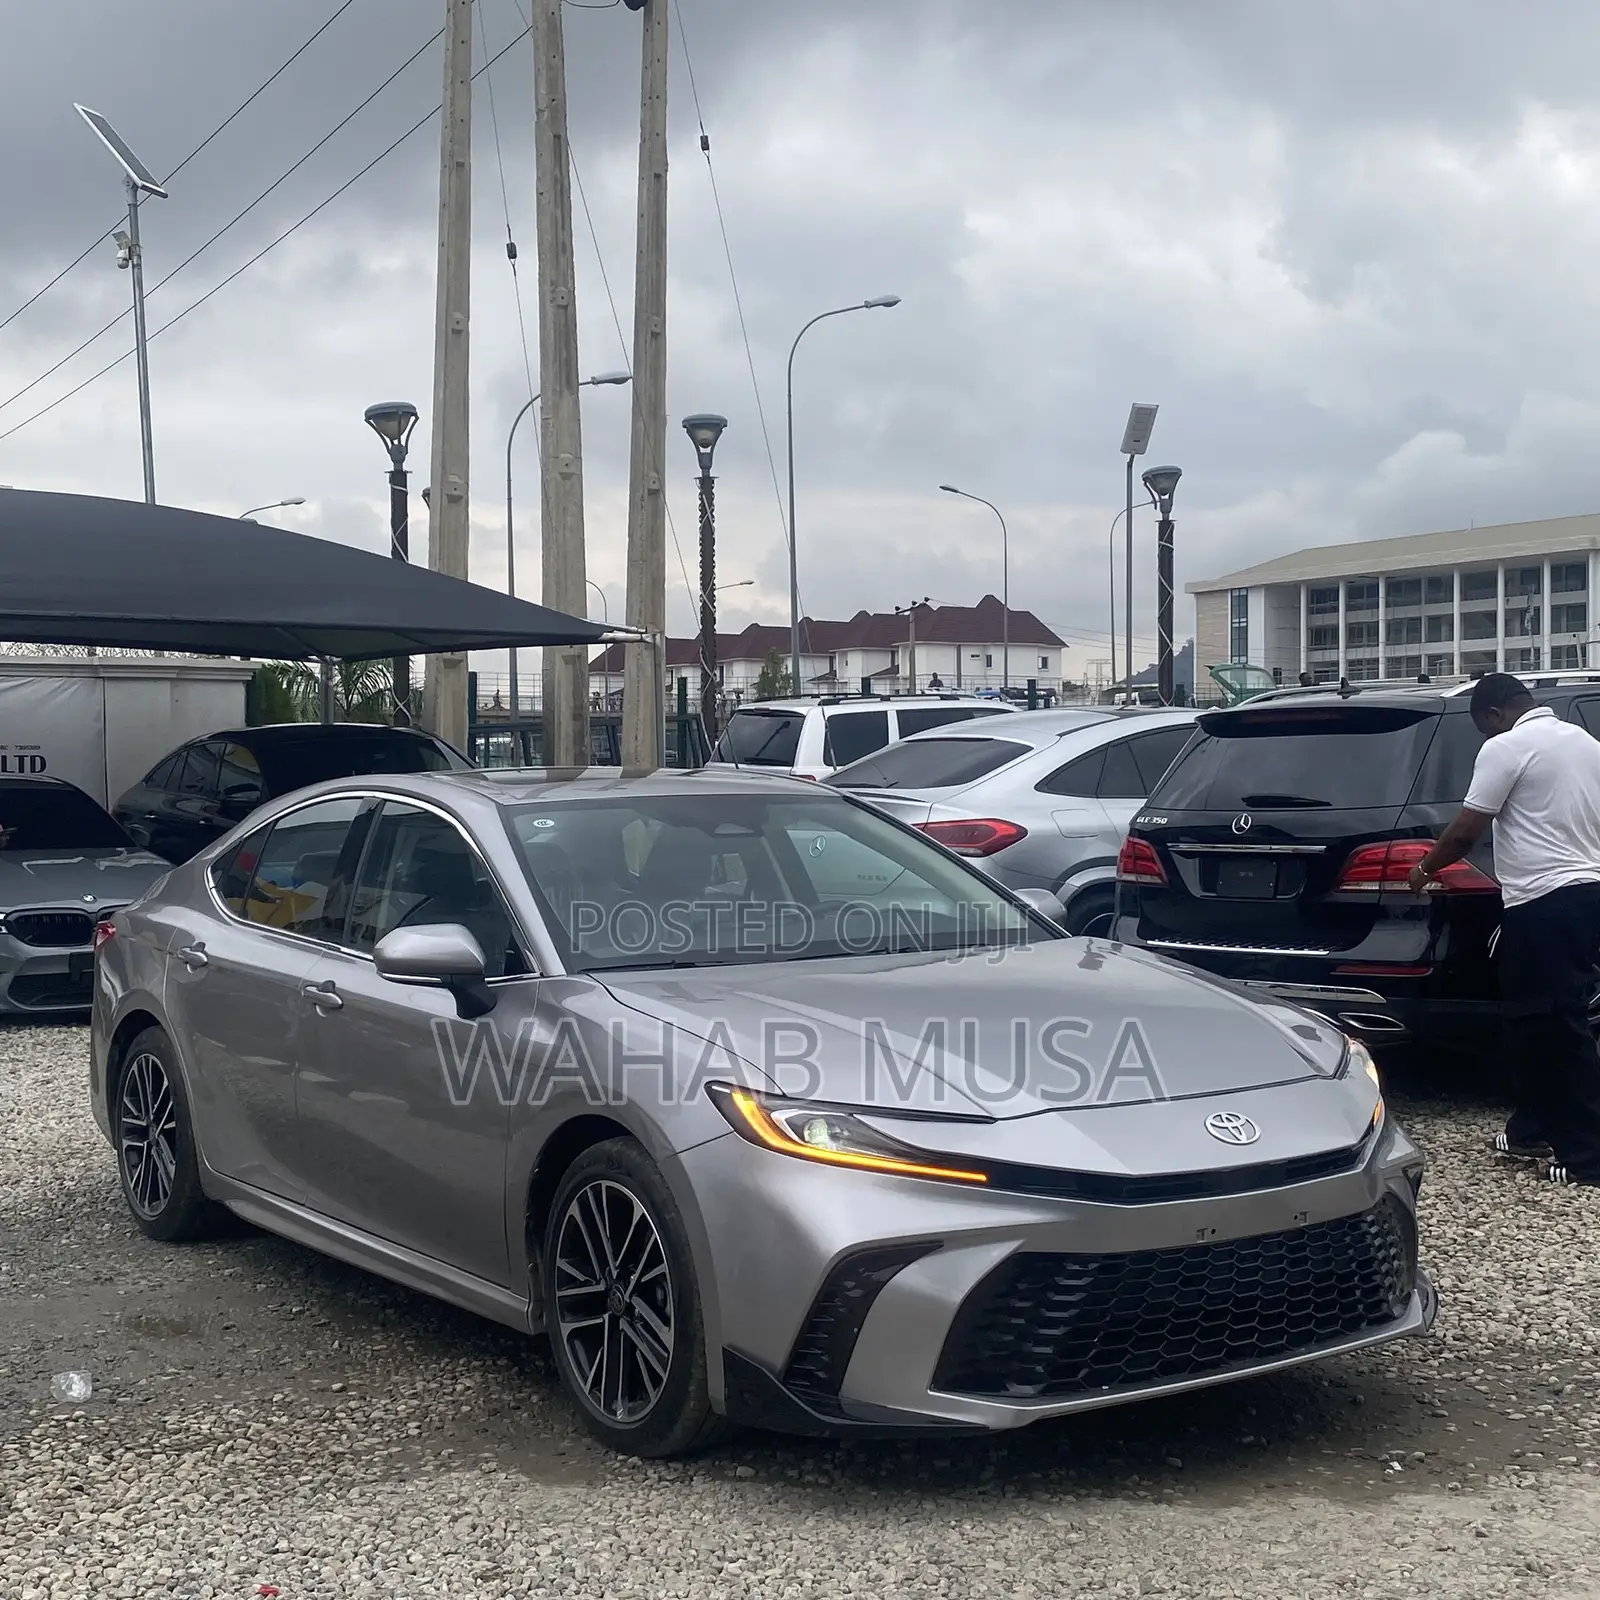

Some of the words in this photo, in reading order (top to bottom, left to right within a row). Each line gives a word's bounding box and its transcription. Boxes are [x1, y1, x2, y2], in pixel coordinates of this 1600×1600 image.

[1, 754, 47, 774] LTD
[1136, 816, 1151, 824] GLE
[1150, 816, 1168, 825] 350
